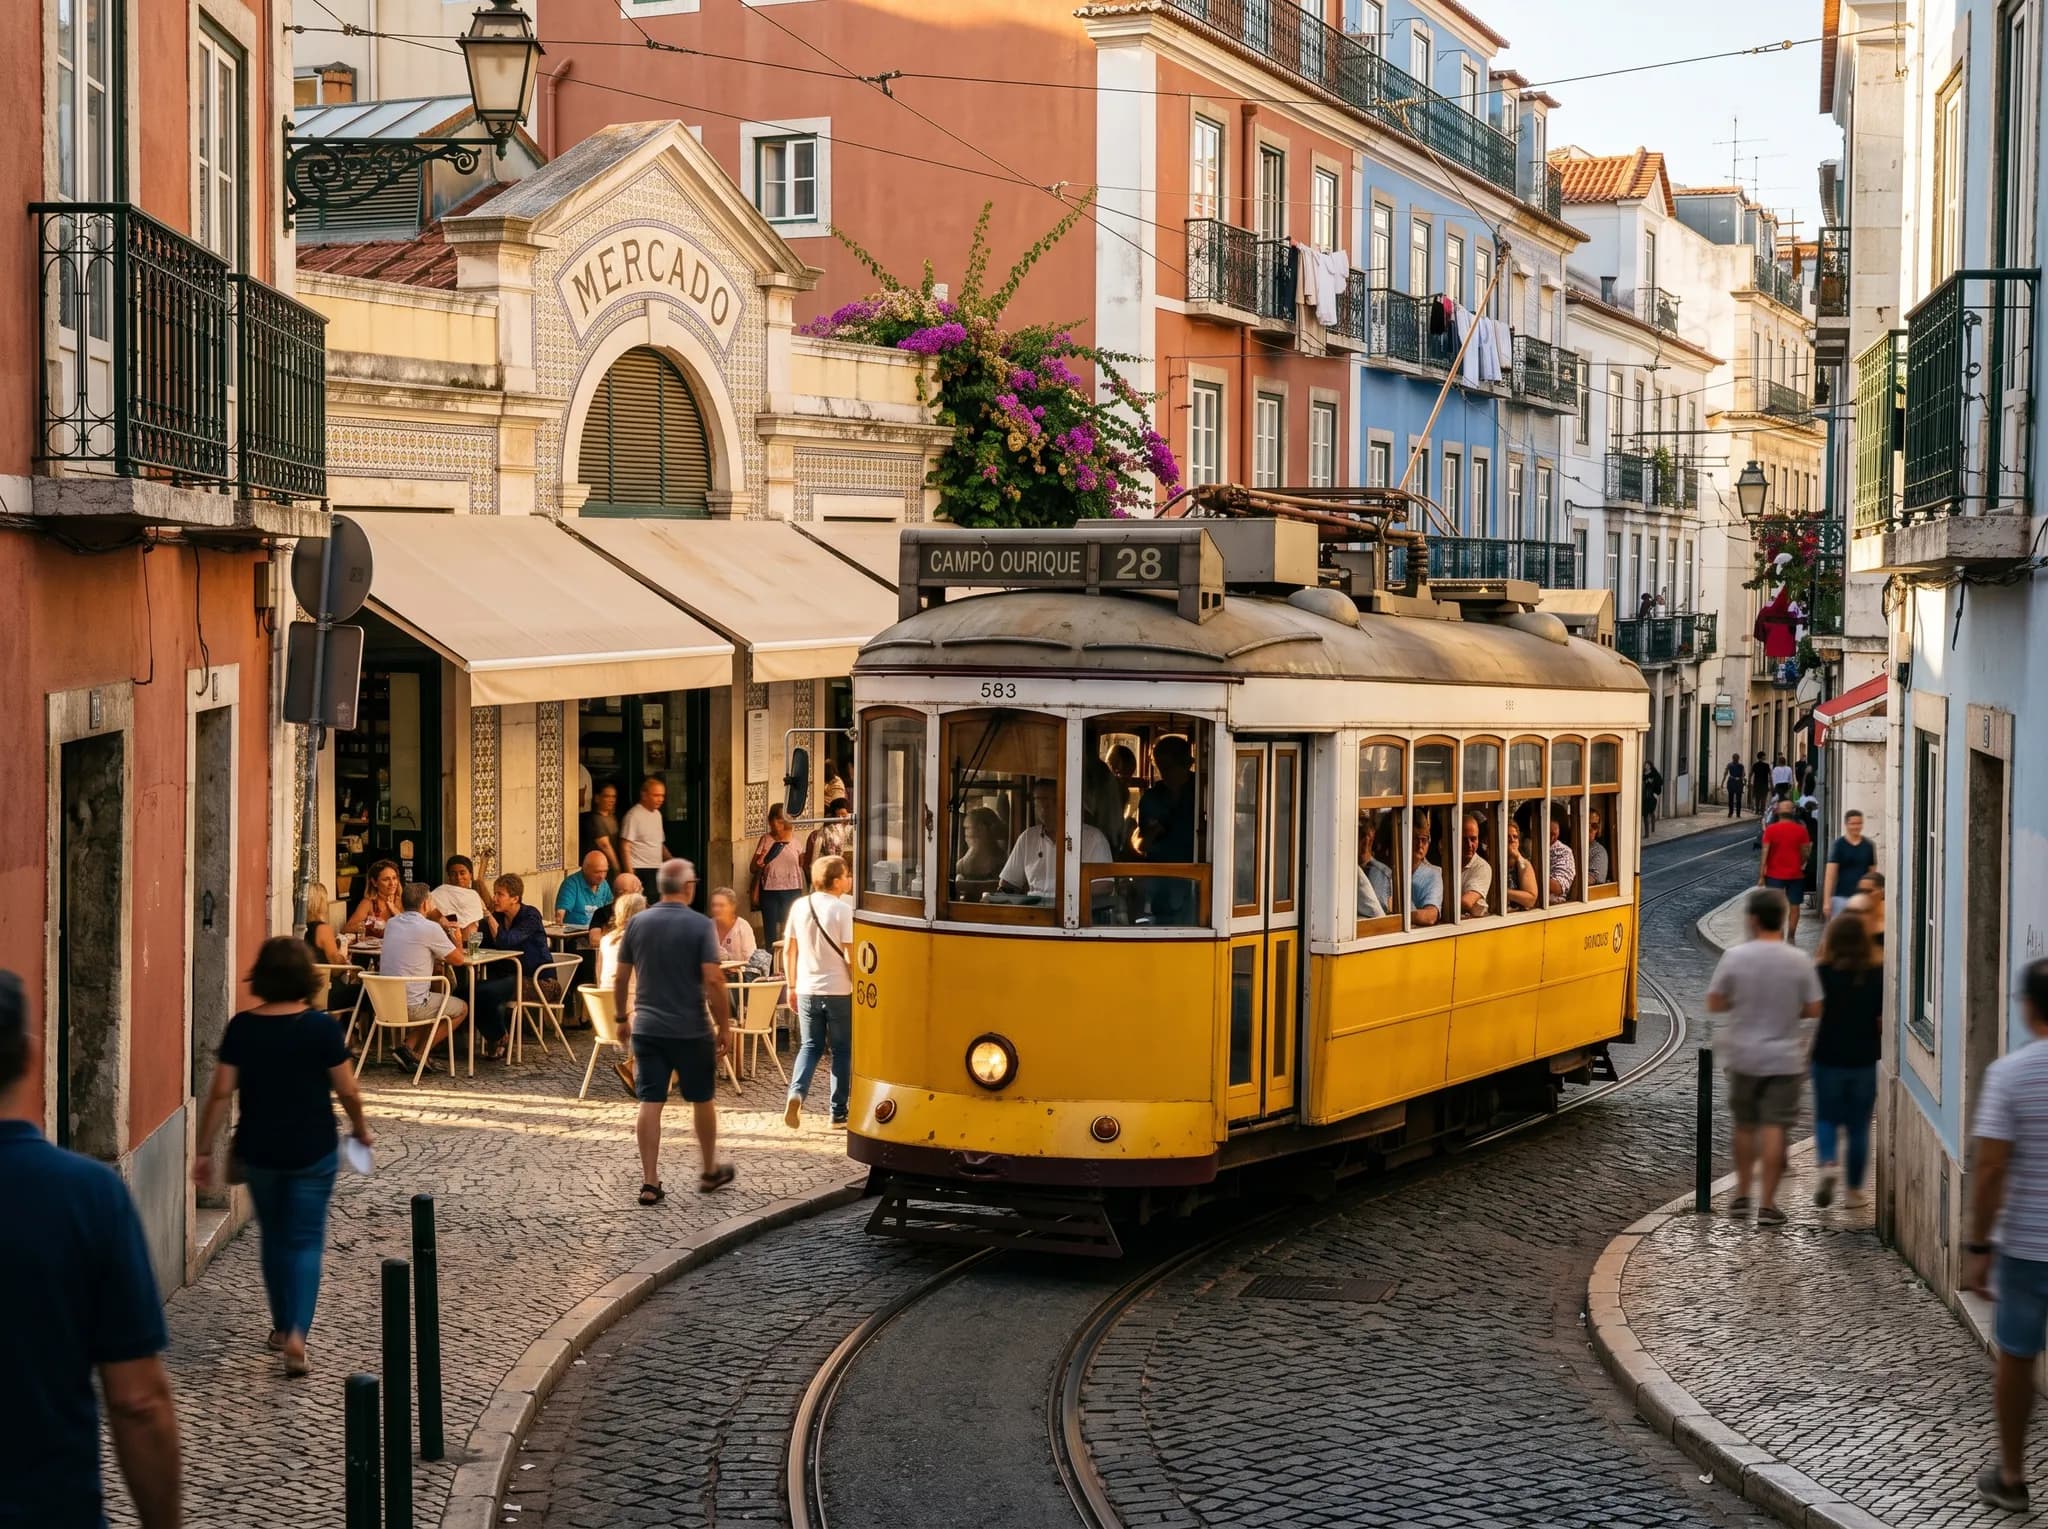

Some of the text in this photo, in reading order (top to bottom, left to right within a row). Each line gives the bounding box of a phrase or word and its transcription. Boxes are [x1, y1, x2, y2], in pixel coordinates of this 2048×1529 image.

[571, 239, 729, 326] MERCADO
[930, 550, 1081, 577] CAMPO OURIQUE
[1116, 547, 1162, 580] 28
[980, 682, 1017, 699] 583
